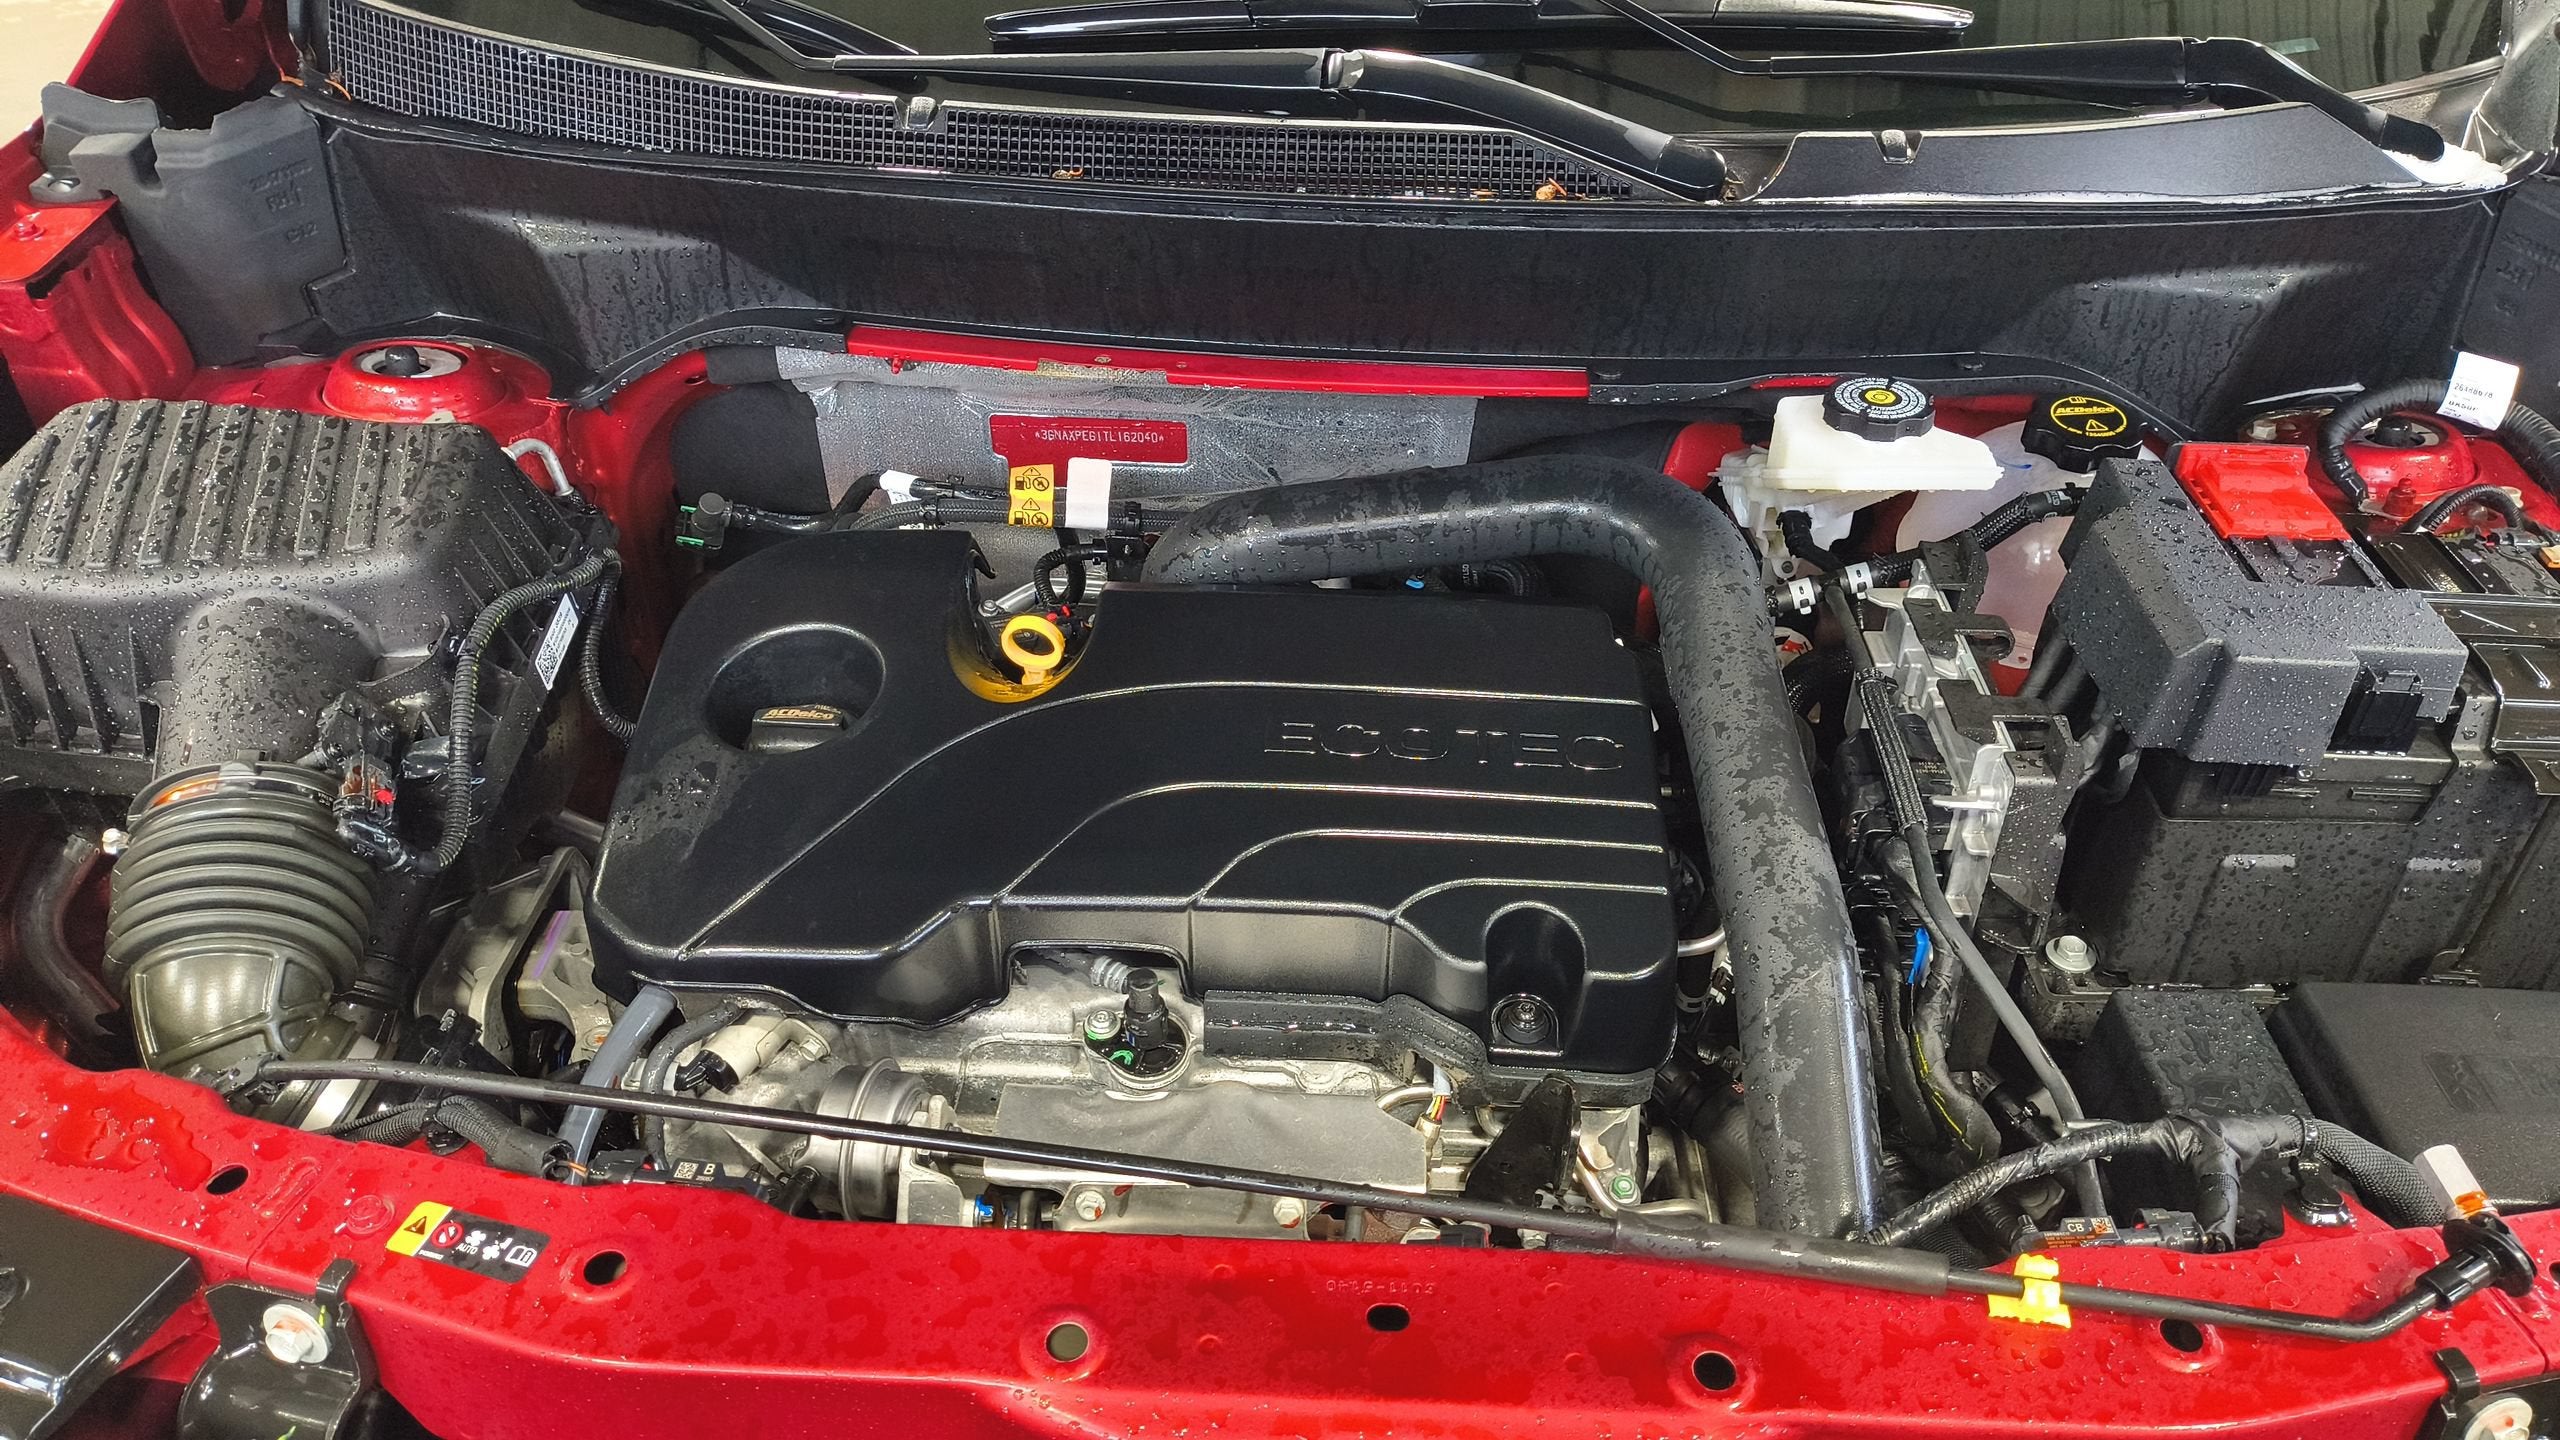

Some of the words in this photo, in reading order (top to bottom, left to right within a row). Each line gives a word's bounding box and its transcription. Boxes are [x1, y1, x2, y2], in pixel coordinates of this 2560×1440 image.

[2055, 405, 2116, 415] ACDelco
[762, 708, 835, 720] ACDelco
[1264, 722, 1625, 771] ECOTEC
[2067, 1223, 2085, 1232] CB
[456, 1242, 479, 1255] AUTO
